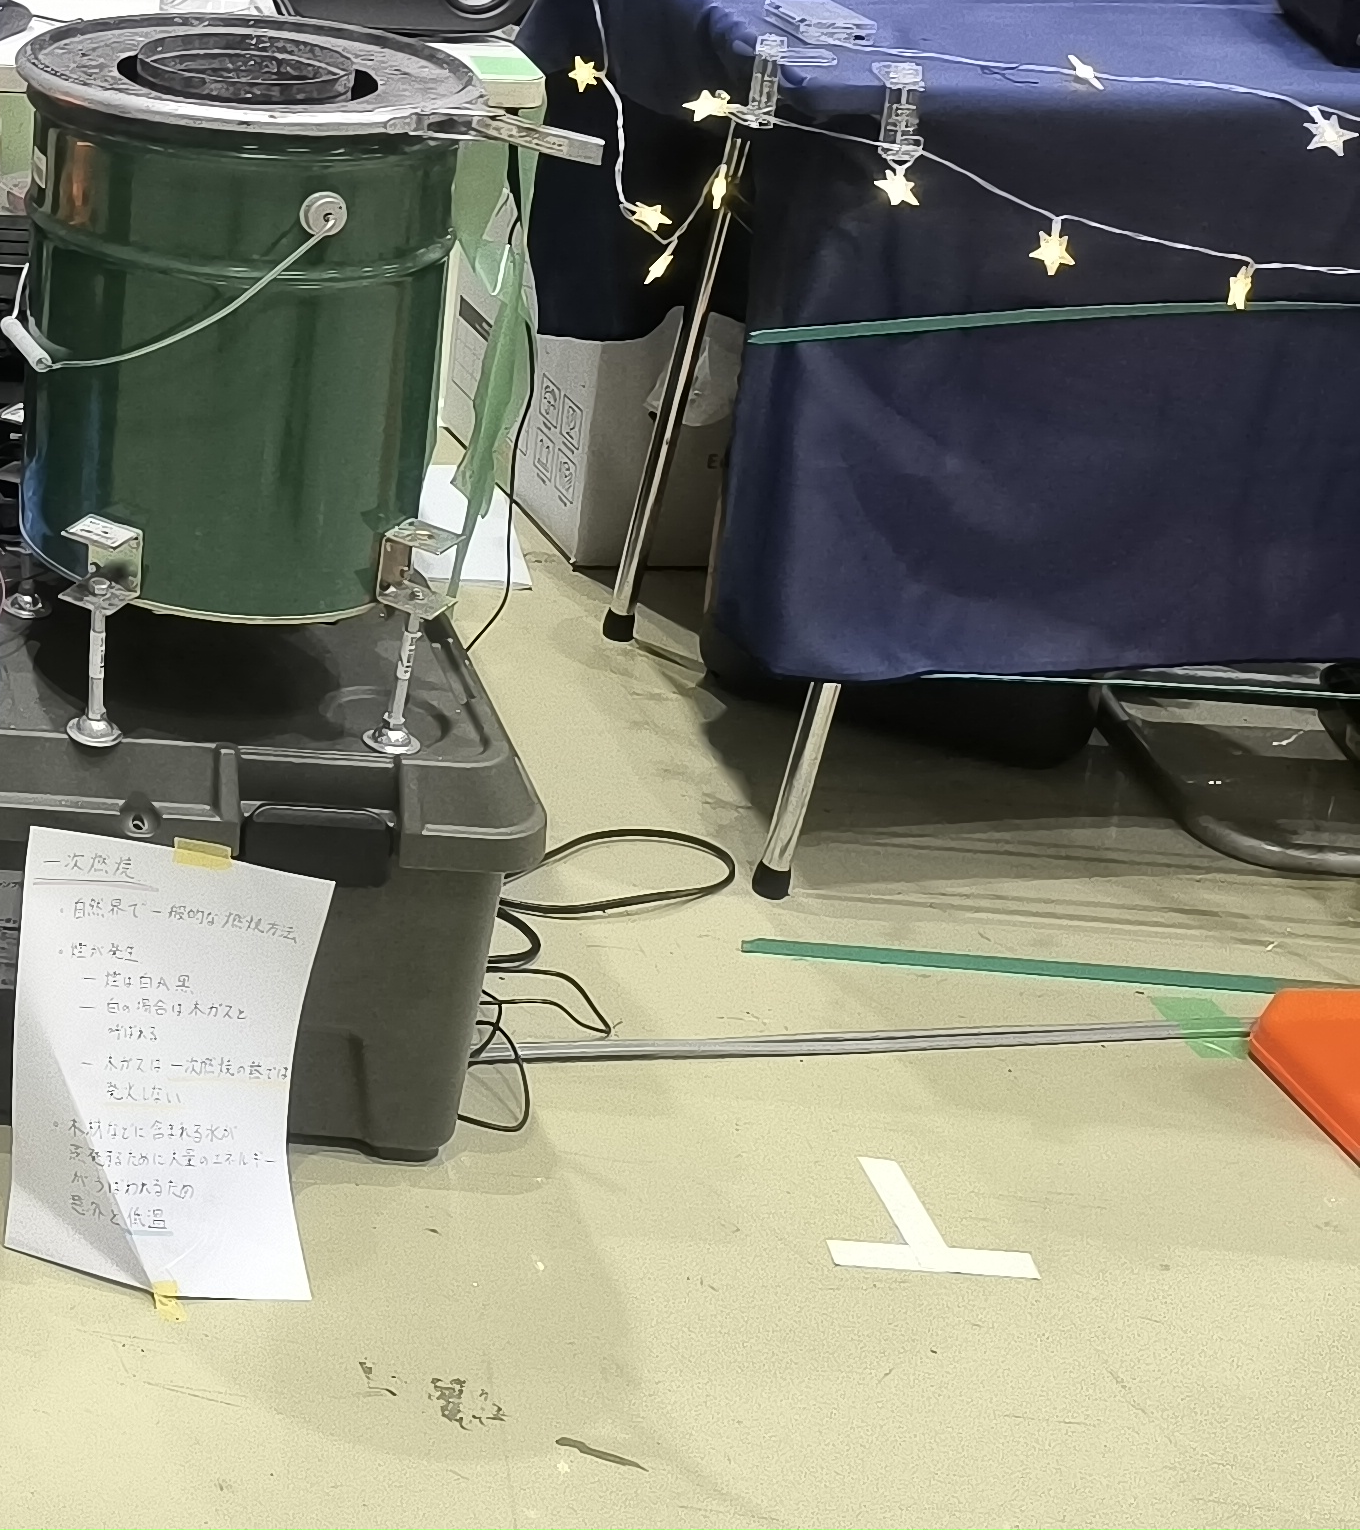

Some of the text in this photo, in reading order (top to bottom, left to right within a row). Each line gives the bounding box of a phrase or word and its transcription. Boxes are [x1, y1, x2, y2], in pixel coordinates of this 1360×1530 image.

[43, 852, 137, 880] 一次燃焼
[73, 898, 300, 946] 自然界で一般的な燃焼方法
[106, 998, 248, 1022] 白の場合は木ガスと
